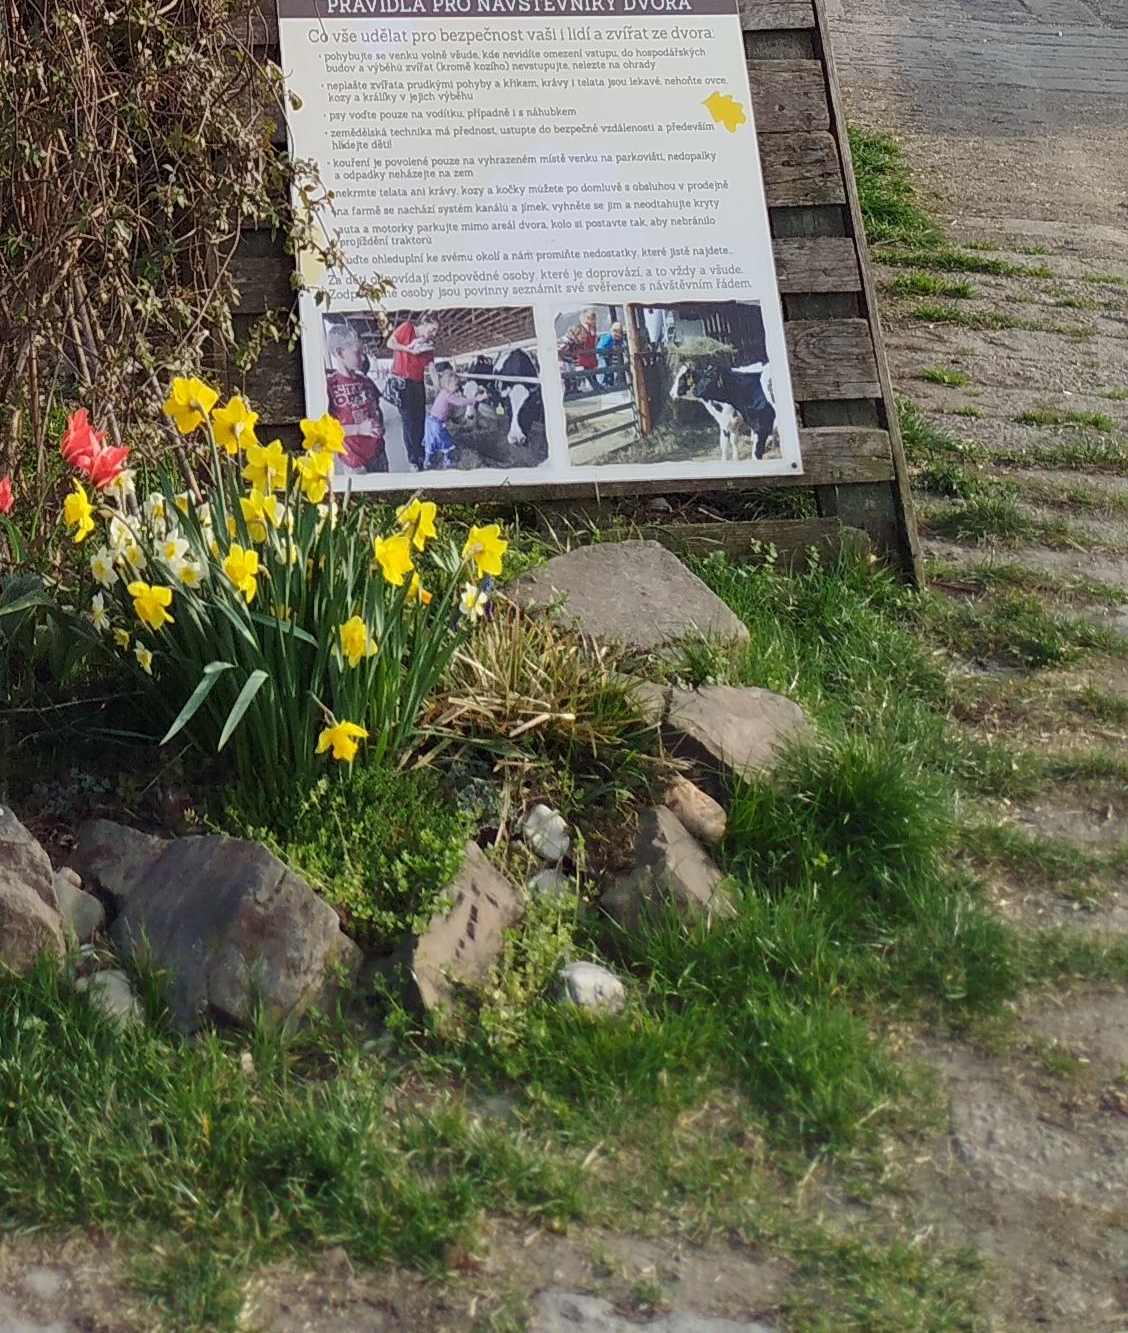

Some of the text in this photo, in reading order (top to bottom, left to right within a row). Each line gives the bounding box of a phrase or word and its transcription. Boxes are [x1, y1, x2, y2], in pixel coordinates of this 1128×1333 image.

[308, 28, 328, 43] Co
[332, 28, 357, 43] vše
[360, 28, 407, 42] udělat
[411, 31, 436, 46] pro
[440, 27, 523, 45] bezpečnost
[526, 26, 556, 41] vaši
[560, 28, 564, 40] i
[567, 26, 590, 40] lidí
[594, 30, 602, 40] a
[605, 25, 648, 40] zvířat
[651, 29, 667, 39] ze
[324, 51, 372, 63] pohybujte
[389, 50, 418, 59] venku
[421, 50, 447, 59] volně
[482, 50, 499, 59] kde
[502, 49, 540, 58] nevidíte
[543, 50, 582, 58] omezení
[621, 48, 633, 57] do
[635, 47, 705, 59] hospodářských
[325, 61, 356, 73] budov
[358, 64, 365, 73] a
[366, 61, 403, 75] výběhů
[404, 61, 434, 72] zvířat
[435, 60, 472, 72] (kromě
[571, 59, 606, 70] nelezte
[607, 61, 621, 70] na
[622, 59, 656, 71] ohrady
[326, 79, 367, 93] neplašte
[369, 79, 404, 90] zvířata
[406, 78, 454, 92] prudkými
[455, 78, 492, 92] pohyby
[494, 80, 501, 88] a
[540, 76, 569, 89] krávy
[571, 78, 575, 87] i
[577, 77, 605, 87] telata
[664, 75, 702, 85] nehoňte
[328, 92, 351, 104] kozy
[354, 94, 360, 102] a
[399, 93, 406, 101] v
[437, 90, 473, 103] výběhu
[328, 112, 346, 123] psy
[348, 109, 377, 120] voďte
[379, 111, 408, 122] pouze
[410, 110, 424, 119] na
[466, 107, 510, 121] případně
[512, 108, 516, 117] i
[518, 109, 524, 117] s
[525, 106, 577, 117] náhubkem
[329, 125, 388, 140] zemědělská
[389, 126, 432, 137] technika
[434, 125, 451, 136] má
[499, 125, 537, 137] ustupte
[538, 123, 552, 134] do
[552, 123, 598, 136] bezpečné
[599, 122, 655, 133] vzdálenosti
[657, 124, 664, 132] a
[665, 121, 715, 134] především
[332, 156, 370, 168] kouření
[373, 158, 382, 169] je
[384, 156, 428, 169] povolené
[430, 157, 460, 168] pouze
[462, 157, 475, 165] na
[477, 153, 537, 167] vyhrazeném
[539, 153, 566, 163] místě
[568, 153, 598, 163] venku
[600, 154, 613, 162] na
[667, 151, 716, 163] nedopalky
[334, 167, 474, 182] a odpadky neházejte na zem
[338, 235, 431, 249] projíždění traktorů
[432, 269, 500, 285] zodpovědné
[539, 267, 570, 283] které
[573, 269, 583, 282] je
[645, 268, 653, 277] a
[655, 267, 667, 279] to
[669, 264, 696, 280] vždy
[699, 267, 707, 275] a
[400, 286, 433, 299] osoby
[438, 286, 460, 298] jsou
[464, 286, 508, 298] povinny
[512, 283, 562, 294] seznámit
[565, 282, 584, 293] své
[587, 281, 636, 292] svěřence
[639, 283, 646, 291] s
[649, 278, 713, 290] návštěvním
